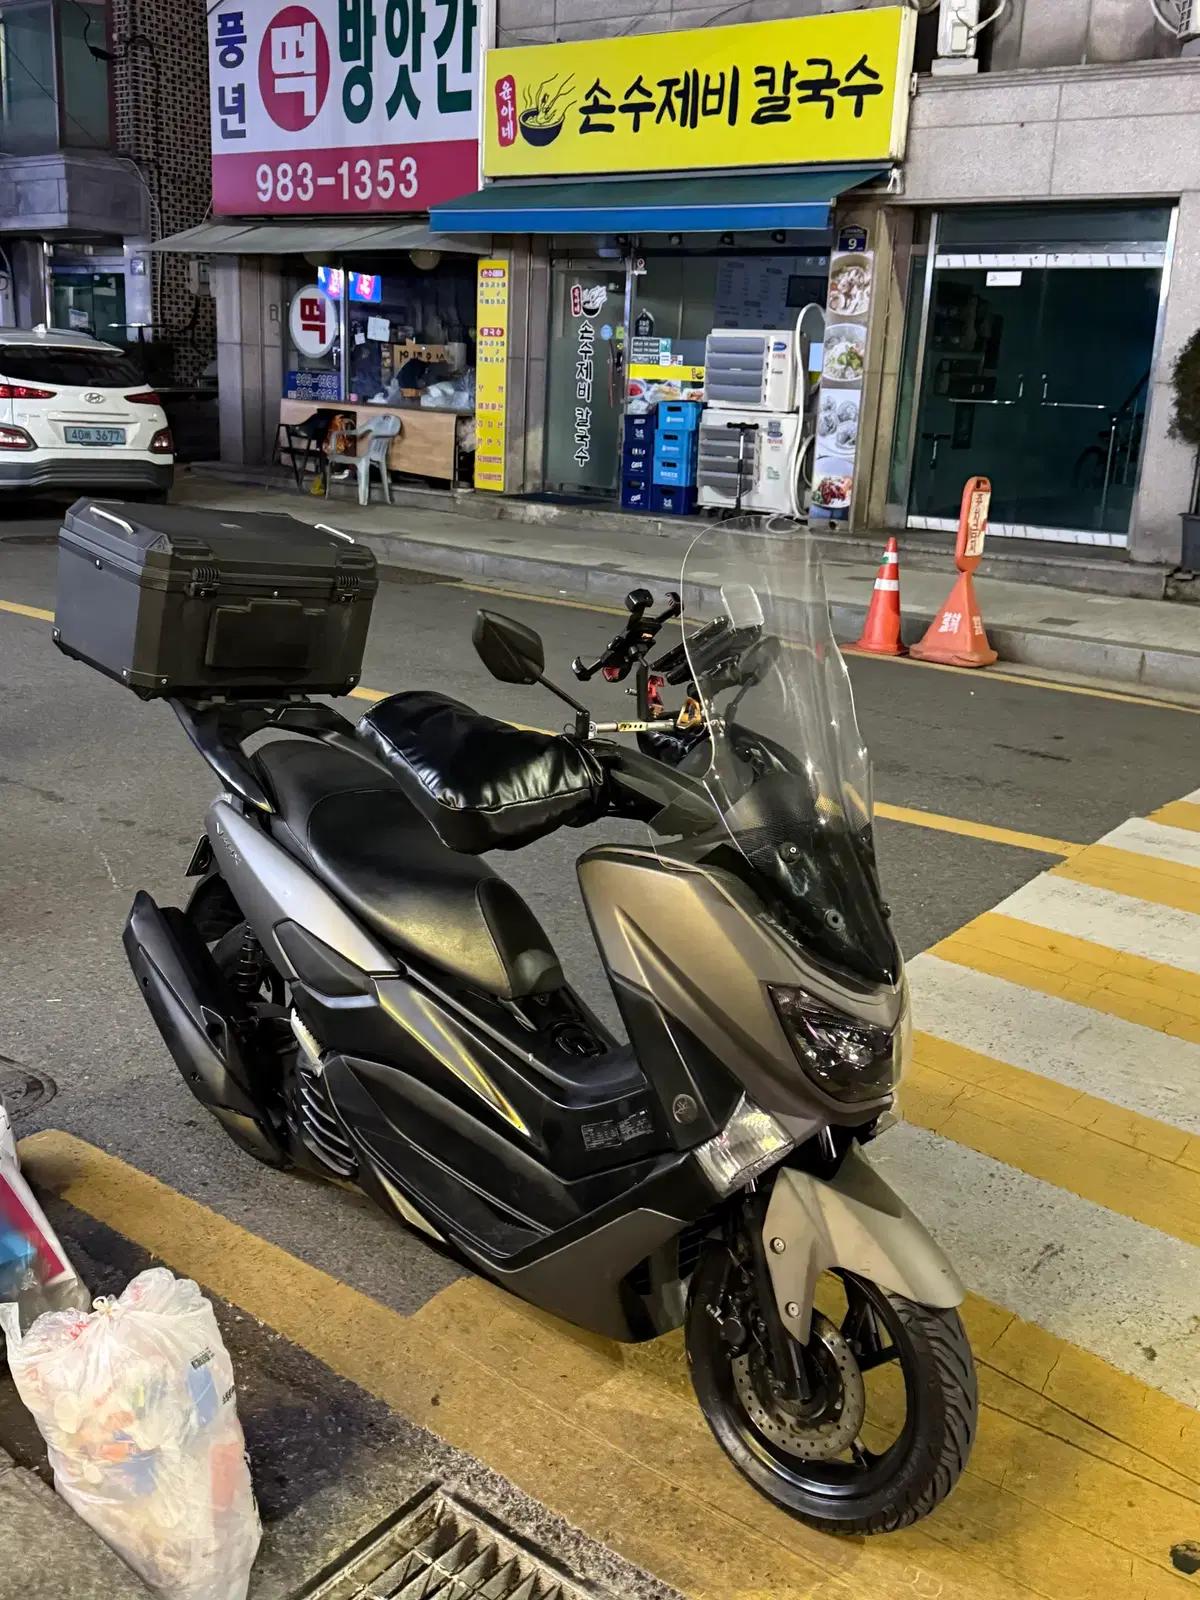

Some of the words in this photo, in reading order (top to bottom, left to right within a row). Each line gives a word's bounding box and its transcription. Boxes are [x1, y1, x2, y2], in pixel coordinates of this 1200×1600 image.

[215, 12, 247, 139] 풍년
[271, 22, 316, 116] 떡
[338, 0, 477, 124] 방앗간
[578, 66, 740, 135] 손수제비
[751, 54, 884, 125] 칼국수
[256, 157, 418, 202] 983-1353
[848, 238, 857, 250] 9
[300, 298, 326, 344] 떡
[576, 320, 595, 402] 손수제비
[95, 430, 121, 441] 3677
[574, 407, 592, 467] 칼국수
